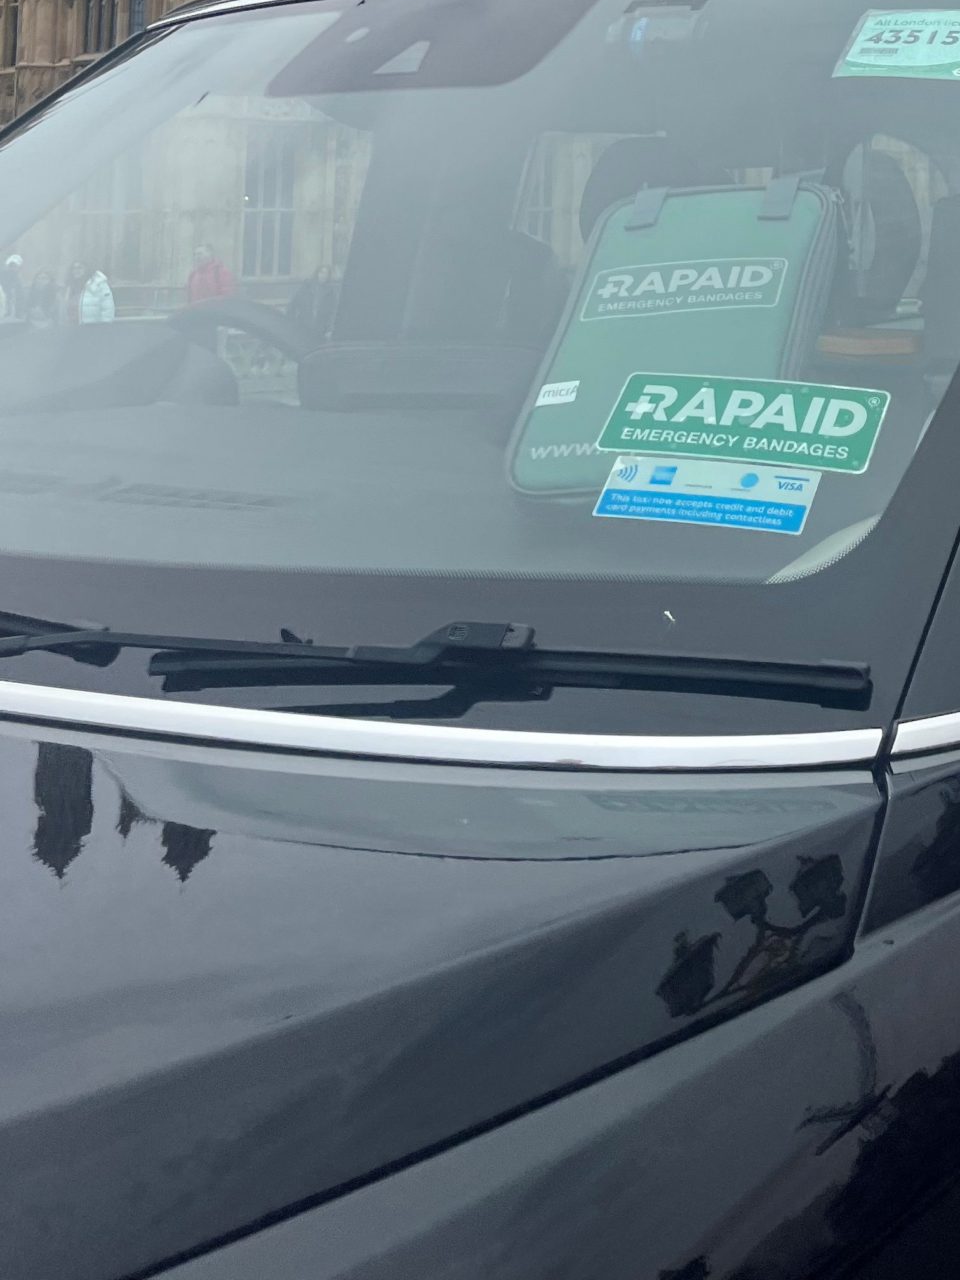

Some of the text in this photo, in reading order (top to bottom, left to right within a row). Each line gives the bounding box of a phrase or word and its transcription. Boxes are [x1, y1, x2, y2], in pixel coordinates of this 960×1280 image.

[895, 18, 941, 27] London
[598, 265, 774, 299] RAPAID
[598, 291, 763, 313] EMERGENCY BANDAGES
[625, 384, 868, 437] RAPAID
[621, 427, 849, 460] EMERGENCY BANDAGES
[777, 481, 804, 492] VISA
[606, 503, 783, 526] card payments including contactless
[610, 493, 630, 503] This
[653, 498, 673, 506] now
[675, 499, 713, 510] accepts
[716, 501, 743, 512] credit
[746, 503, 765, 514] and
[767, 506, 794, 518] debit
